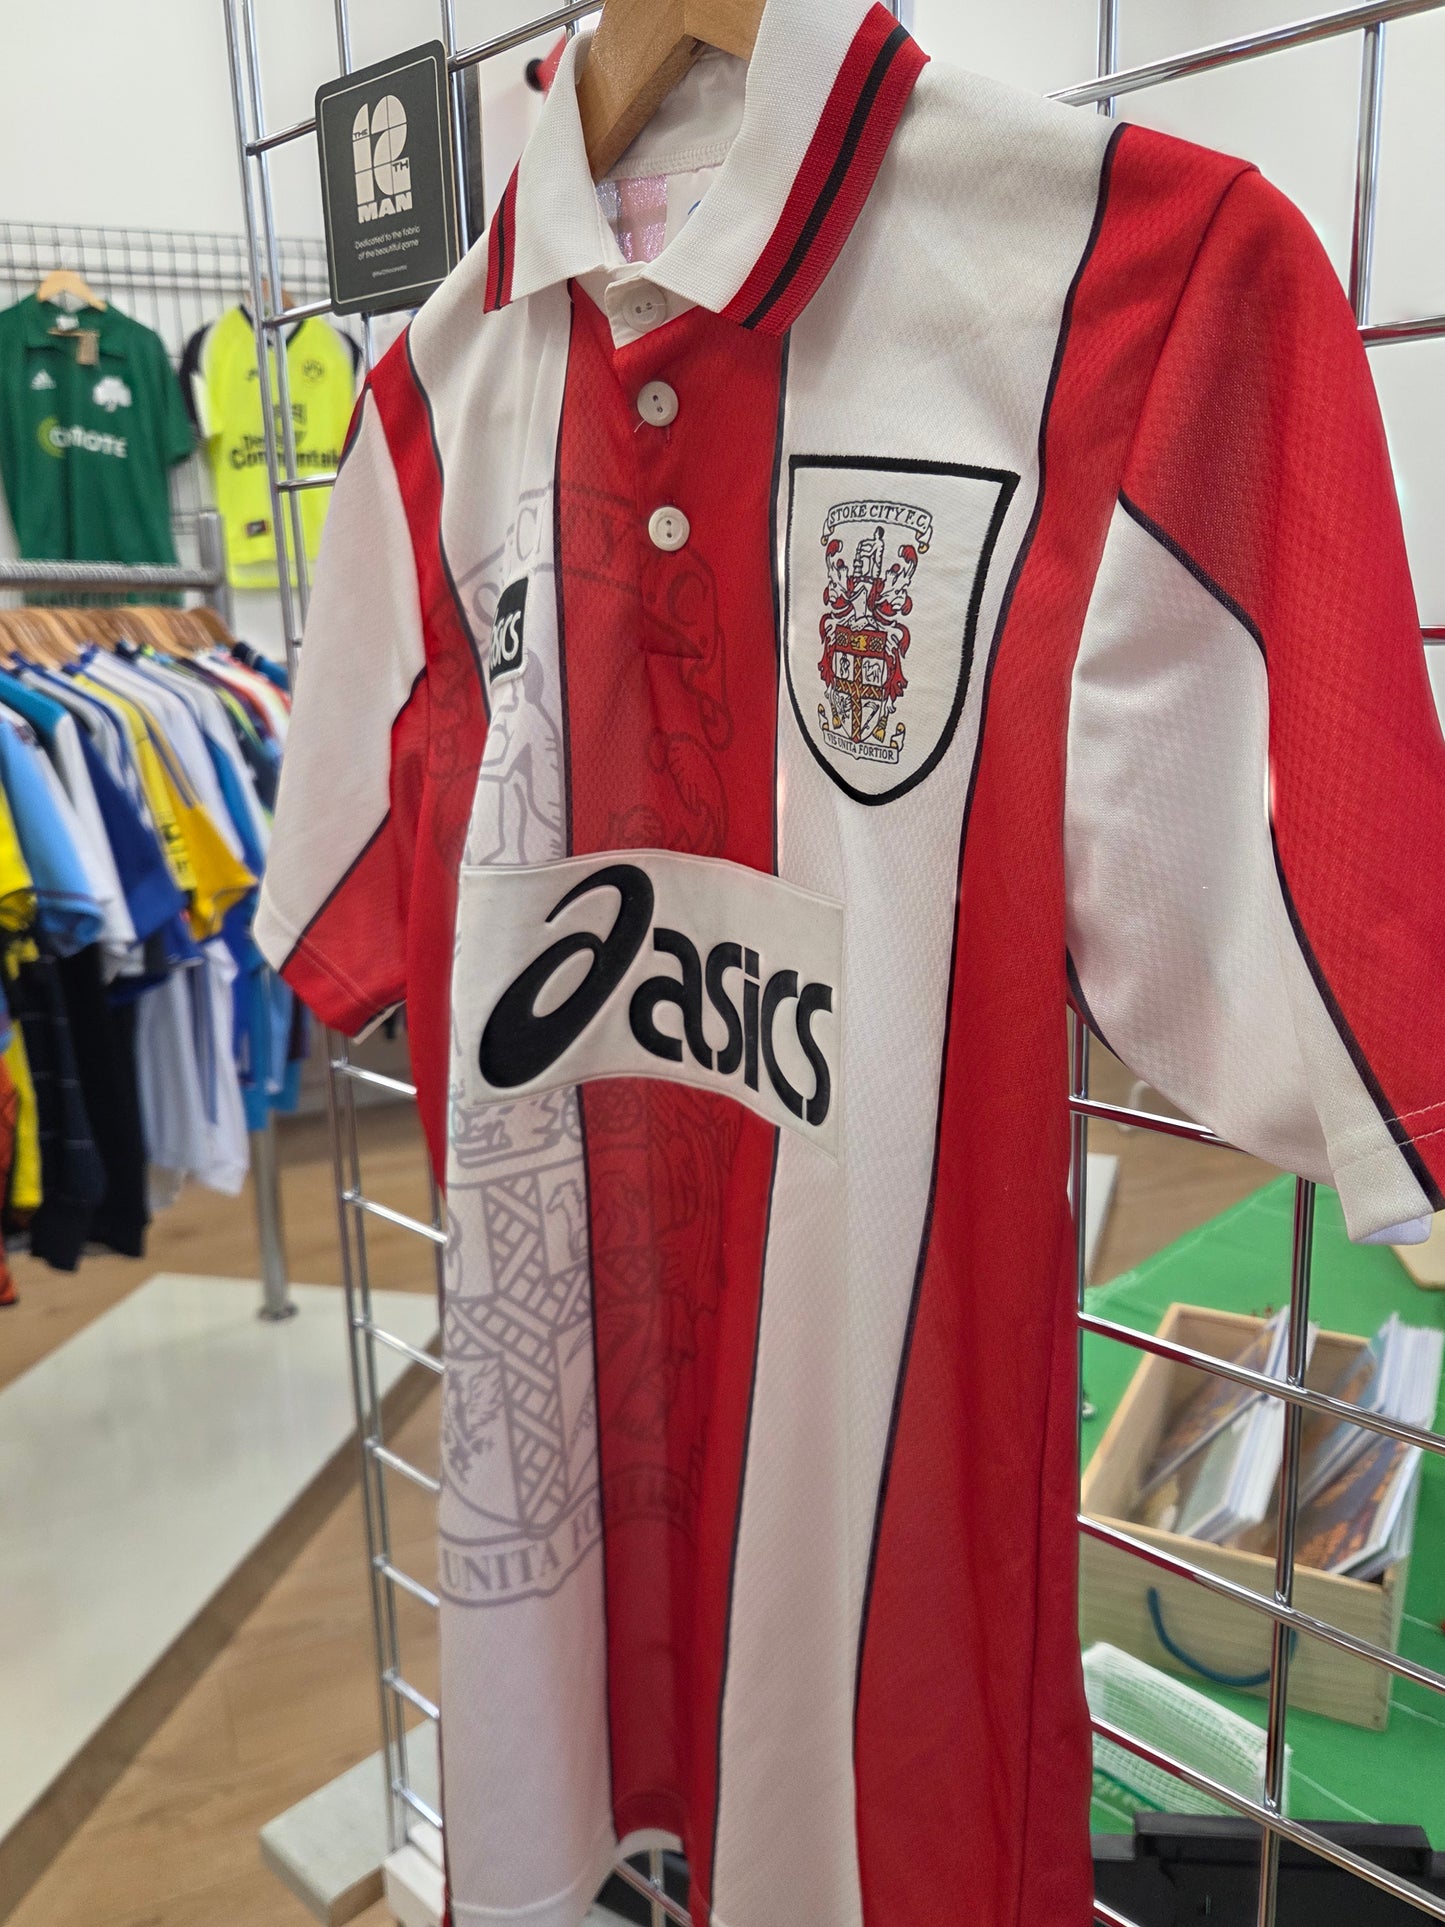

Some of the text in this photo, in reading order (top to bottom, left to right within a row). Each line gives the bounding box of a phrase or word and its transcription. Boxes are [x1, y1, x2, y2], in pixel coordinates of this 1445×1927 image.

[353, 129, 369, 139] THE
[392, 159, 409, 173] TH
[357, 191, 413, 224] MAN
[354, 234, 385, 250] Dedicated
[391, 231, 402, 240] the
[402, 225, 421, 237] fabric
[357, 251, 366, 261] of
[365, 249, 375, 259] the
[401, 239, 420, 251] game
[829, 504, 928, 530] STOKE CITY F.C.
[827, 733, 895, 761] VIS UNITA FORTIOR
[629, 927, 834, 1127] asics
